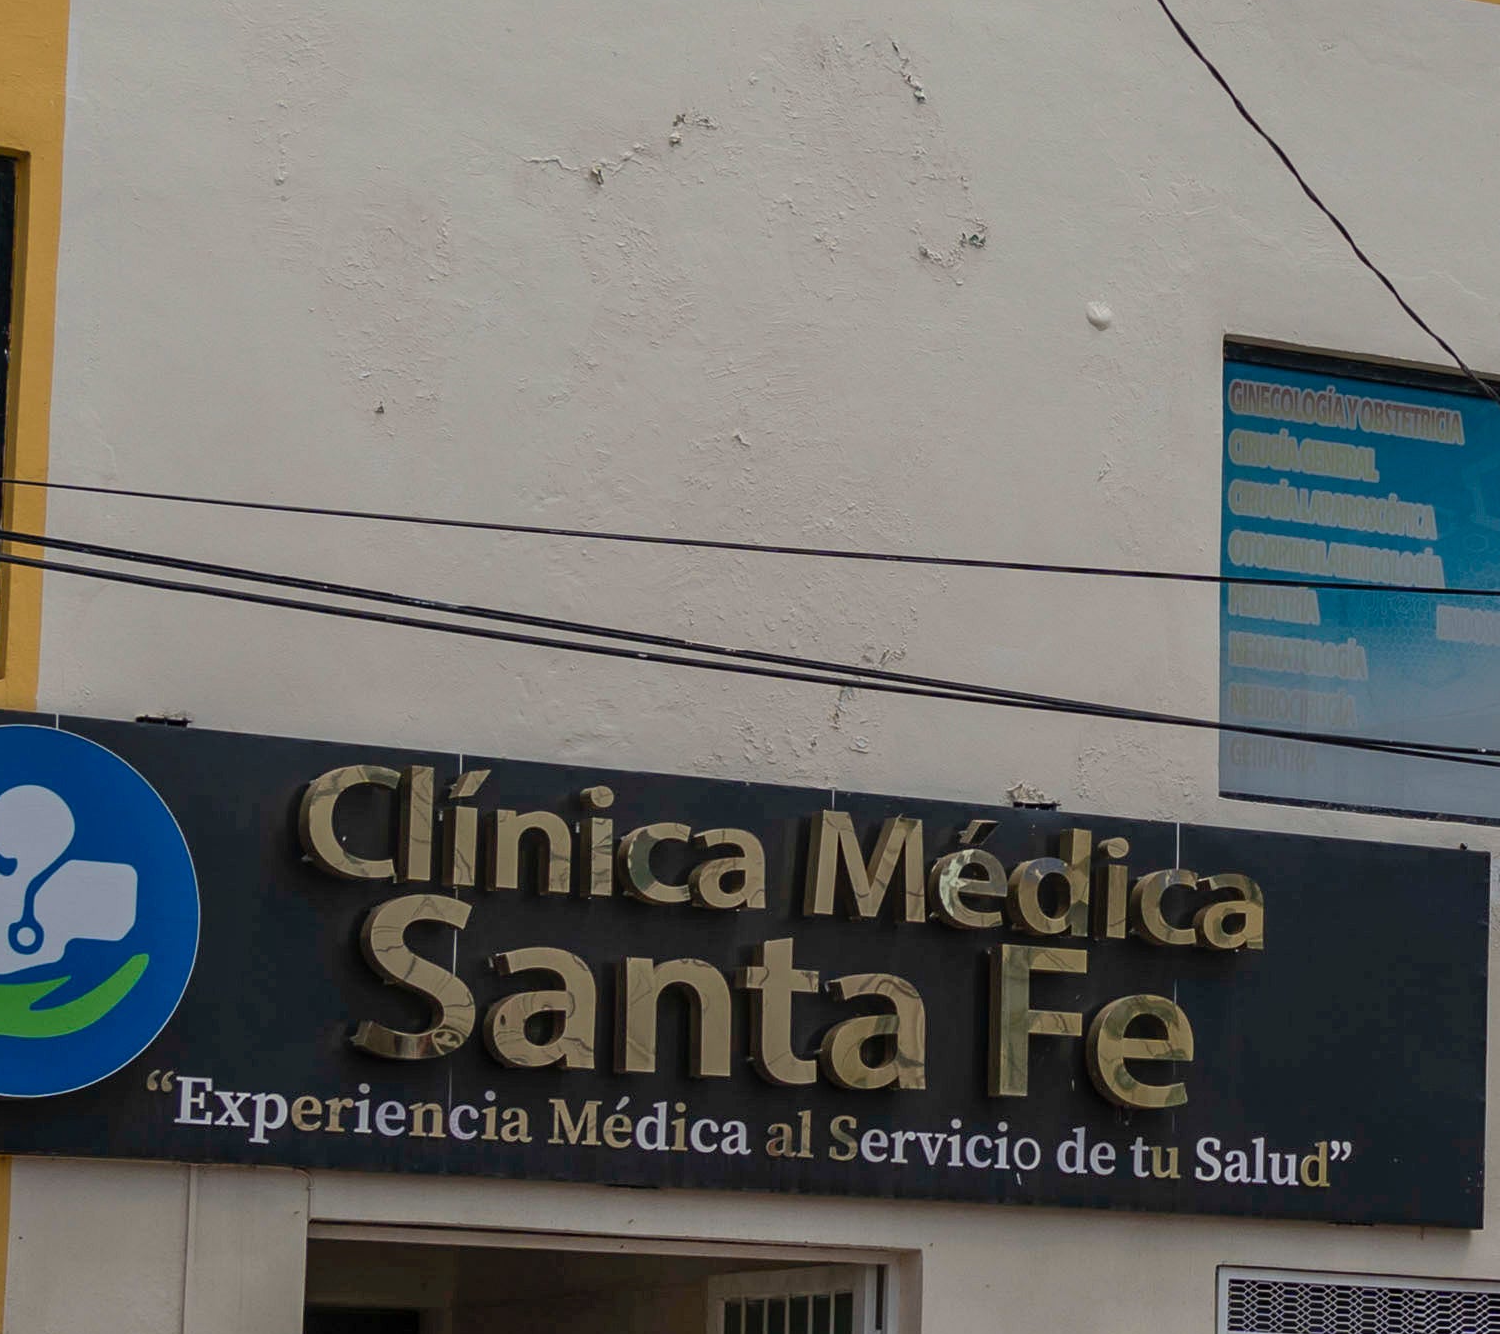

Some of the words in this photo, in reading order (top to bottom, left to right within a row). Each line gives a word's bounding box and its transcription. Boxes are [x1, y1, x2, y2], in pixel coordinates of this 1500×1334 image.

[1359, 397, 1466, 446] OBSTETRICIA
[299, 763, 767, 910] Clínica
[804, 808, 1265, 951] Médica
[351, 893, 927, 1091] Santa
[987, 943, 1195, 1110] Fe
[547, 1095, 752, 1157] Médica
[765, 1110, 814, 1159] al
[828, 1113, 1042, 1170] Servicio
[1056, 1127, 1116, 1175] de
[1130, 1135, 1181, 1181] tu
